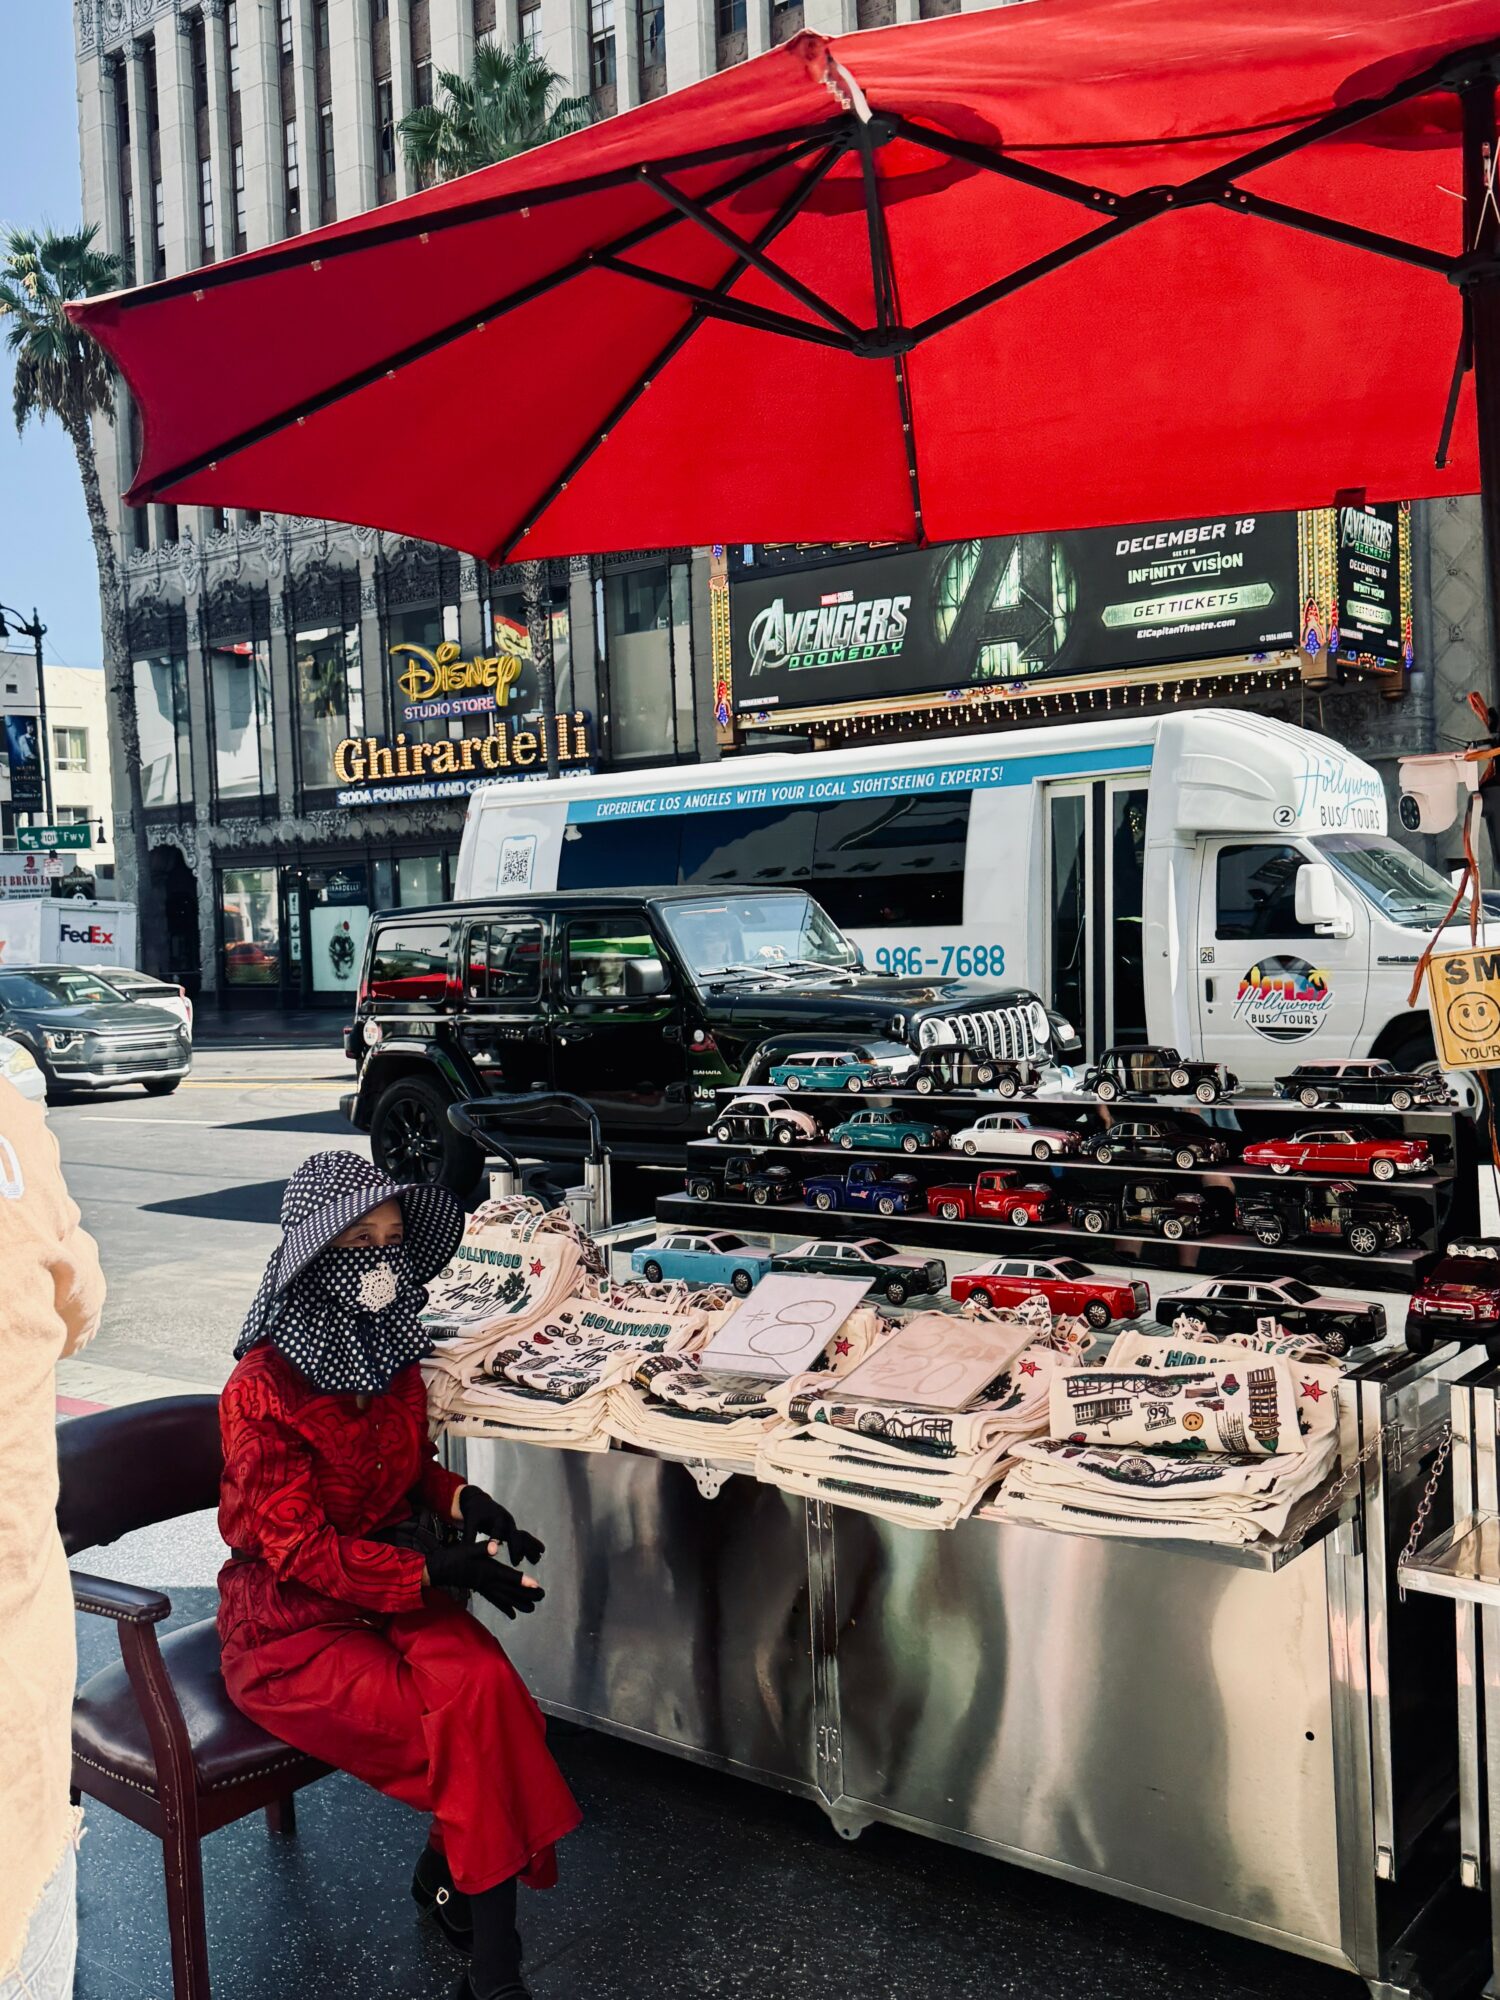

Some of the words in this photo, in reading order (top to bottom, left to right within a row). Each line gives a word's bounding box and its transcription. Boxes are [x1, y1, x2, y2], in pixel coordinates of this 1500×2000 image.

[1116, 523, 1226, 556] DECEMBER
[1235, 518, 1255, 536] 18
[1128, 562, 1187, 584] INFINITY
[1192, 552, 1243, 573] VISION
[1349, 559, 1380, 577] DECEMBER
[1133, 602, 1165, 618] GET
[1169, 592, 1239, 613] TICKETS
[748, 596, 911, 676] AVENGERS
[1137, 619, 1236, 639] ElCapitanTheatre.com
[788, 641, 904, 668] DOOMSDAY
[403, 704, 450, 720] STUDIO
[452, 697, 496, 713] STORE
[334, 710, 590, 784] Ghirardelli
[338, 789, 373, 805] SODA
[373, 783, 435, 803] FOUNTAIN
[437, 781, 465, 797] AND
[596, 799, 657, 816] EXPERIENCE
[659, 796, 681, 811] LOS
[684, 792, 732, 809] ANGELES
[736, 788, 767, 804] WITH
[771, 785, 804, 801] YOUR
[809, 782, 846, 798] LOCAL
[851, 773, 935, 794] SIGHTSEEING
[940, 766, 1004, 785] EXPERTS!
[1280, 809, 1291, 822] 2
[1320, 805, 1341, 827] BUS
[1351, 807, 1380, 830] TOURS
[44, 834, 55, 842] 101
[63, 831, 85, 843] Fwy
[61, 924, 113, 944] FedEx
[876, 945, 1004, 976] 986-7688
[1202, 951, 1213, 962] 26
[1233, 987, 1333, 1021] Hollywood
[1251, 1014, 1271, 1024] BUS
[1283, 1014, 1318, 1025] TOURS
[694, 1085, 716, 1099] Jee
[457, 1246, 523, 1270] OLLYWOOD
[469, 1272, 495, 1294] Los
[581, 1312, 672, 1338] HOLLYWOOD
